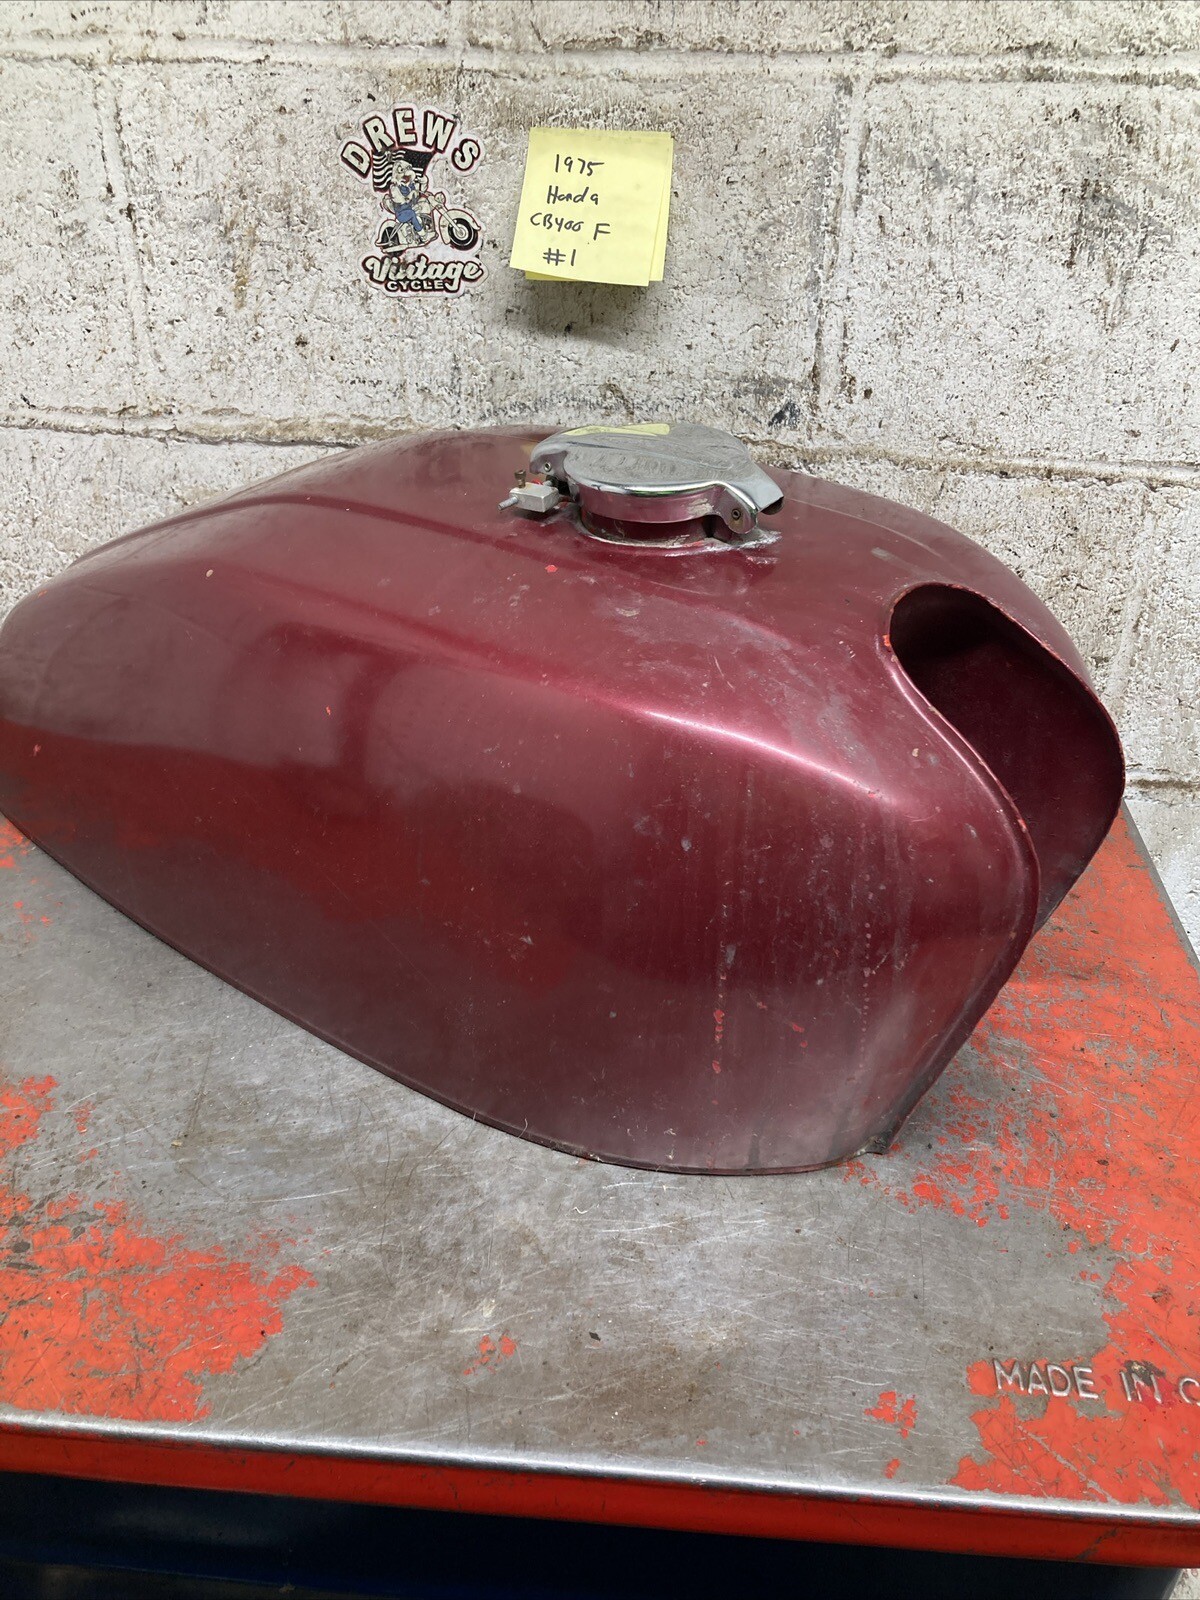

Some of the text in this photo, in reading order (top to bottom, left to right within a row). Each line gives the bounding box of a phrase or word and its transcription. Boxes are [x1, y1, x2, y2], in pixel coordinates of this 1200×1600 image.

[341, 108, 481, 179] DREWS
[555, 154, 605, 177] 1975
[547, 185, 599, 206] Honda
[530, 212, 611, 241] CB400 F
[542, 247, 577, 267] #1
[362, 255, 484, 292] Vintage
[993, 1358, 1099, 1399] MADE
[1119, 1369, 1162, 1404] IN
